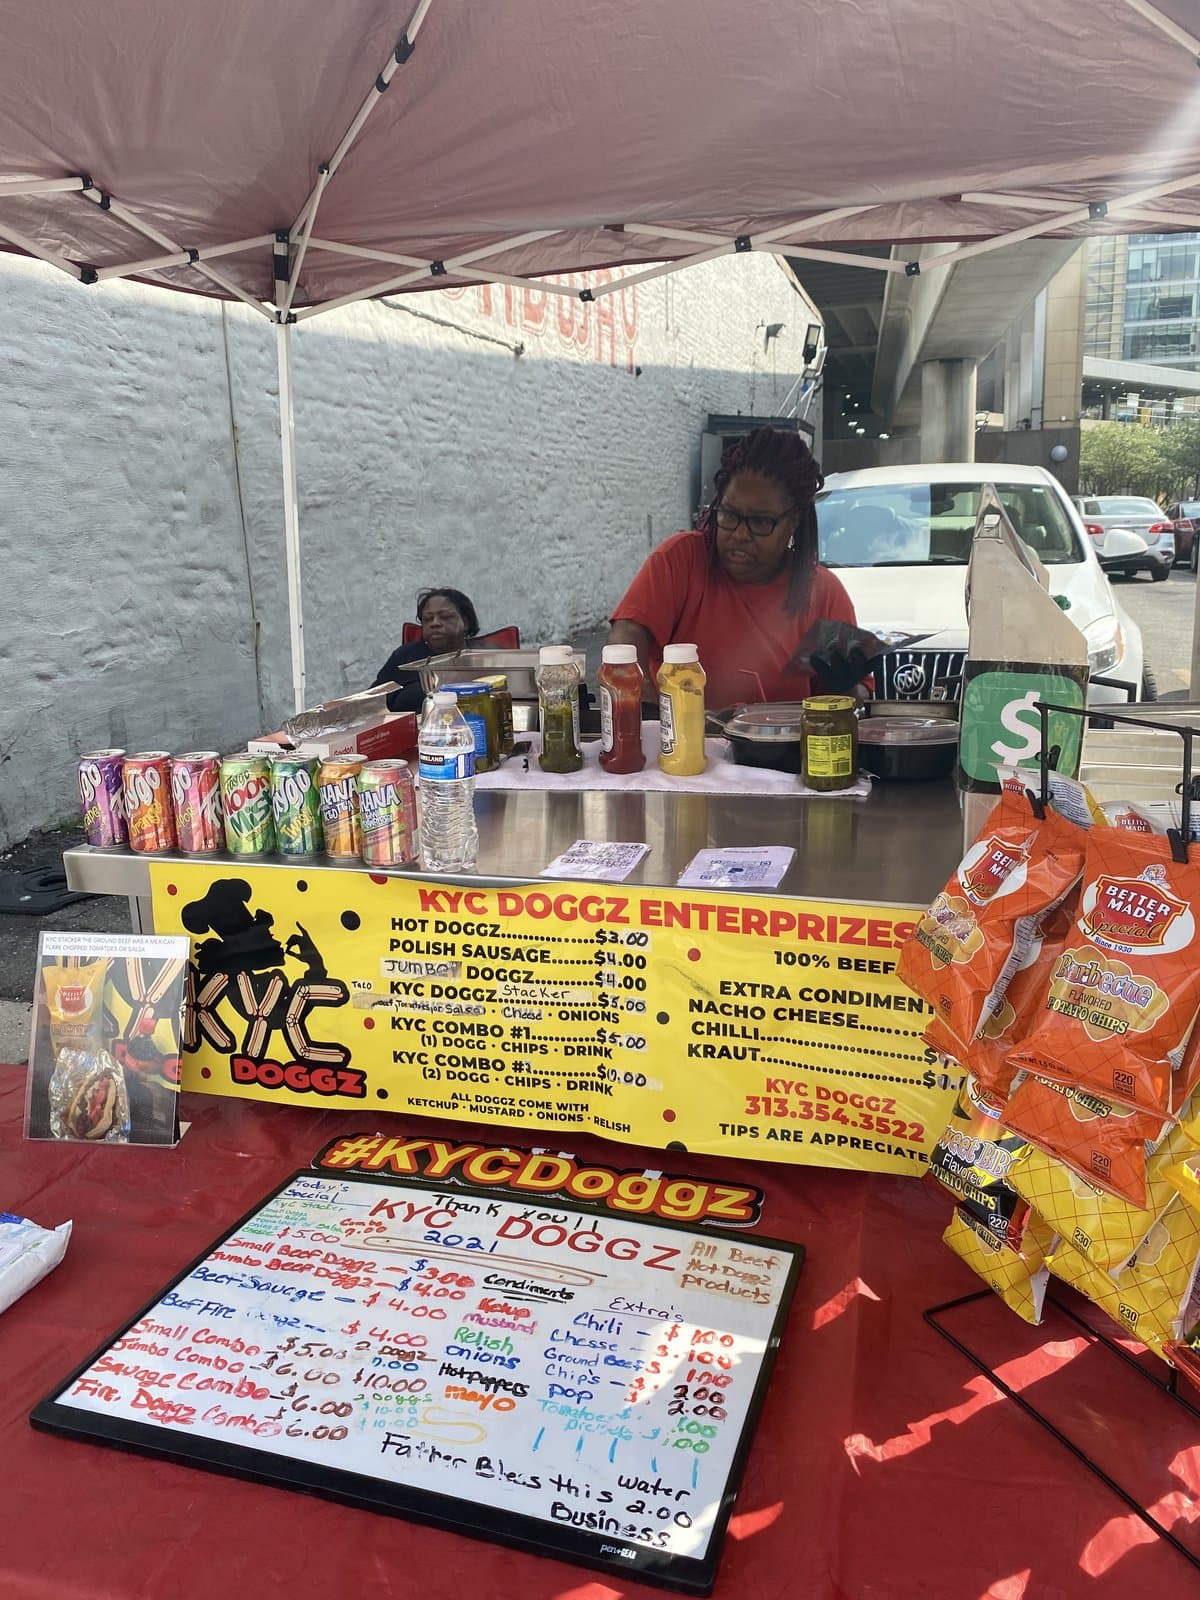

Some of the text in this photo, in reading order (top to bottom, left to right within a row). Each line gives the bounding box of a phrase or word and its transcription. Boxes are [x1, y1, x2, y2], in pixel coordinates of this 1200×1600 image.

[1105, 885, 1171, 916] BETTER
[1107, 898, 1157, 923] MADE
[391, 917, 429, 934] HOT
[434, 920, 501, 939] DOGGZ
[418, 889, 918, 949] KYC DOGGZ ENTERPRIZES
[1083, 911, 1165, 937] Special
[389, 938, 647, 970] POLISH SAUSAGE $4.00
[1094, 936, 1134, 954] Since 1930
[466, 965, 536, 985] DOGGZ
[774, 951, 896, 975] 100% BEEF
[389, 981, 426, 997] KYC
[430, 984, 498, 1003] DOGGZ
[719, 980, 792, 1000] EXTRA
[1056, 954, 1153, 1008] Barbecue
[1069, 989, 1113, 1011] FLAVORED
[557, 1010, 620, 1025] ONIONS
[689, 999, 861, 1029] NACHO CHEESE
[1089, 1010, 1130, 1035] CHIPS
[390, 1016, 427, 1033] KYC
[432, 1021, 505, 1039] COMBO
[510, 1025, 532, 1040] #1
[691, 1021, 761, 1041] CHILLI
[420, 1035, 613, 1060] (1) DOGG CHIPS DRINK
[688, 1043, 761, 1061] KRAUT
[392, 1051, 506, 1074] KYC COMBO
[233, 1058, 363, 1095] DOGGZ
[422, 1066, 614, 1097] (2) DOGG CHIPS DRINK
[1115, 1071, 1134, 1085] 220
[450, 1092, 590, 1112] ALL DOGGZ COME WITH
[765, 1078, 897, 1115] KYC DOGGZ
[407, 1097, 632, 1133] KETCHUP MUSTARD ONIONS RELISH
[745, 1095, 925, 1143] 313.354.3522
[719, 1123, 760, 1139] TIPS
[766, 1127, 804, 1143] ARE
[943, 1153, 986, 1187] Flavored
[1093, 1152, 1110, 1168] 220
[331, 1135, 749, 1217] #KYCDoggz
[963, 1181, 998, 1211] CHIPS
[369, 1198, 682, 1271] KYC DOGGZ
[990, 1215, 1008, 1230] 220
[225, 1237, 276, 1254] Small
[277, 1244, 323, 1260] Beef
[423, 1229, 499, 1254] 2021
[1074, 1230, 1090, 1247] 230
[205, 1251, 262, 1267] Jumbo
[686, 1258, 720, 1275] Hot
[690, 1241, 781, 1270] All Beef
[483, 1273, 576, 1300] Condiments
[608, 1296, 685, 1324] Extra's
[1120, 1304, 1138, 1322] 230
[573, 1312, 624, 1336] Chili
[191, 1328, 261, 1356] Combo
[454, 1326, 514, 1356] Relish
[174, 1346, 245, 1374] Combo
[543, 1346, 600, 1368] Ground
[177, 1373, 271, 1401] Combo
